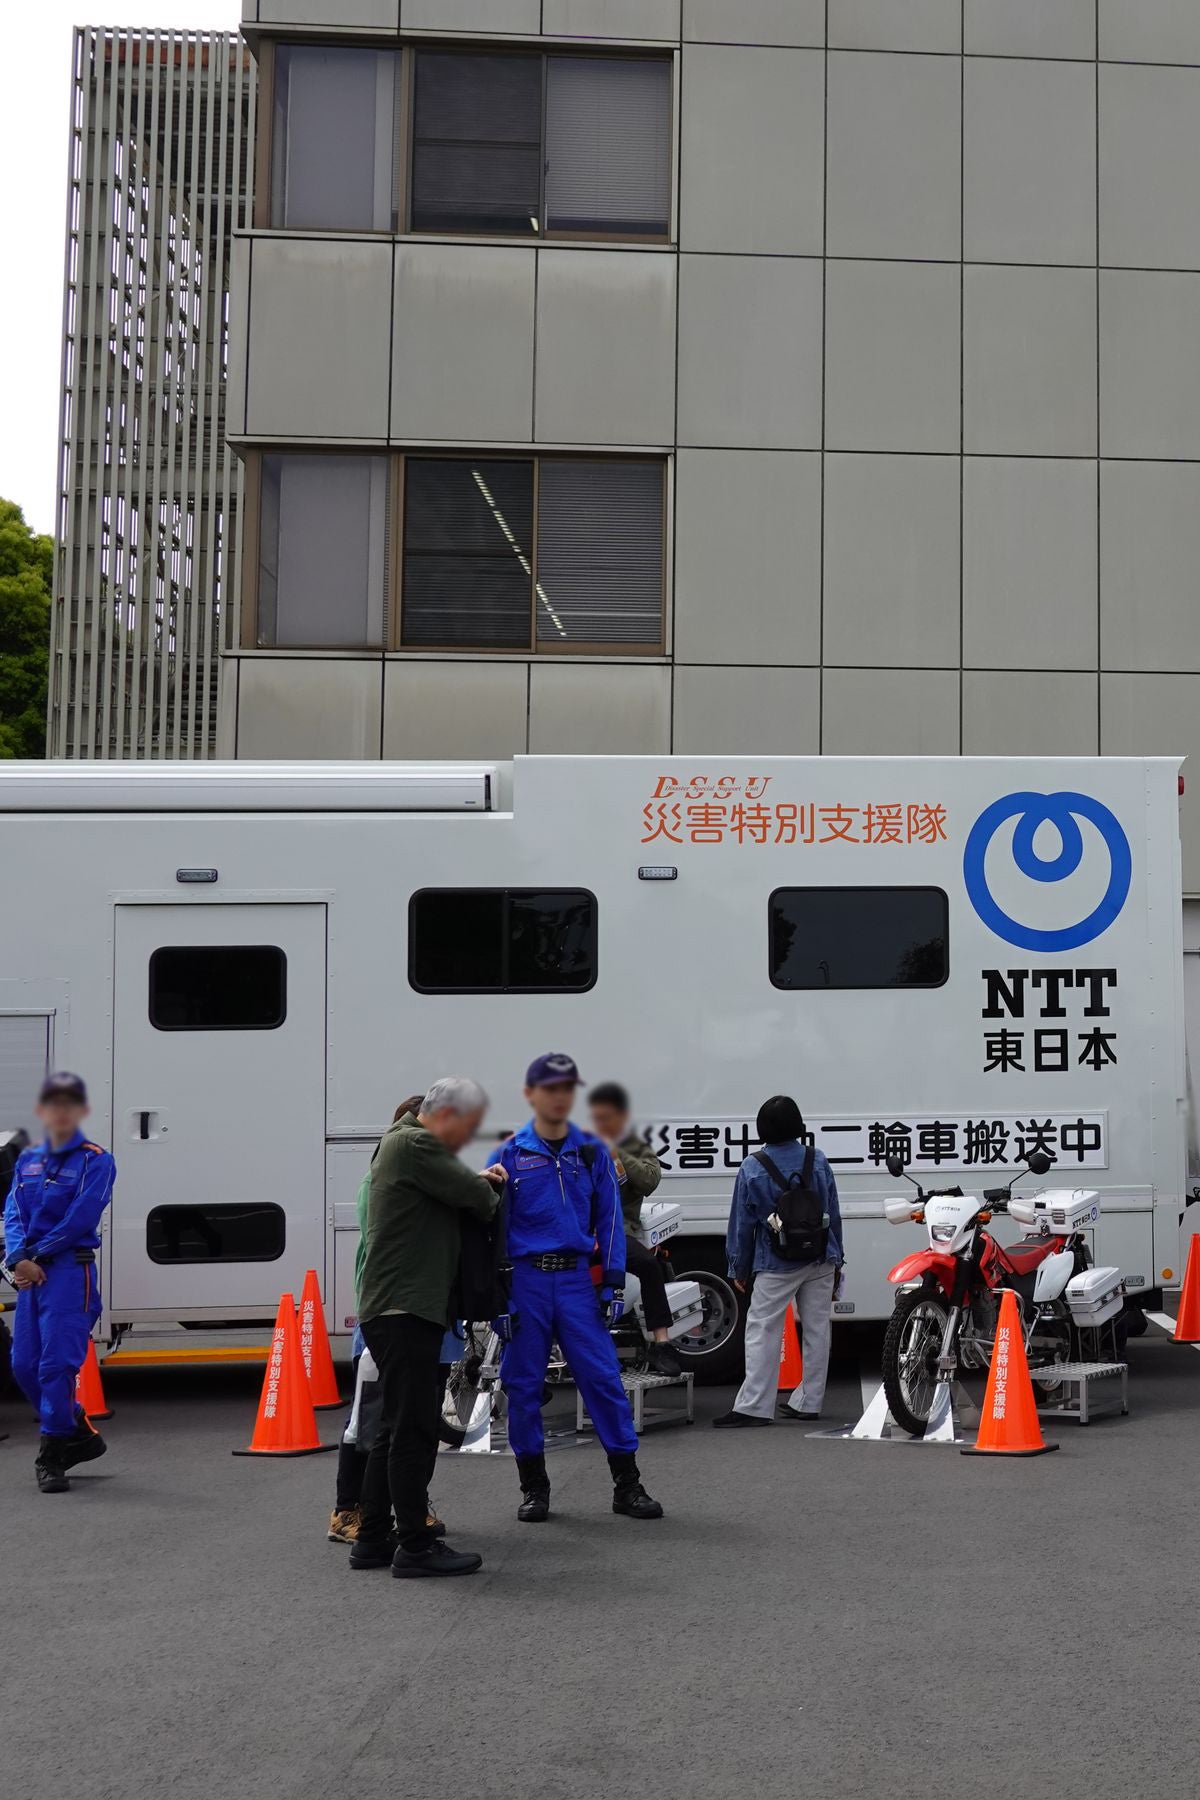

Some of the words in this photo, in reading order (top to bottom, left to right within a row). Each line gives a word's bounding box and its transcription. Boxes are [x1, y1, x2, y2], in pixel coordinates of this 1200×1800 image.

[650, 776, 773, 799] DSSU
[718, 785, 741, 793] Support
[640, 802, 948, 845] 災害特別支援隊
[981, 968, 1118, 1019] NTT
[983, 1026, 1118, 1073] 東日本
[643, 1117, 1101, 1171] 害出二輪車搬送中
[263, 1327, 286, 1419] 災害特別支援隊
[992, 1327, 1011, 1420] 災害特別支援隊
